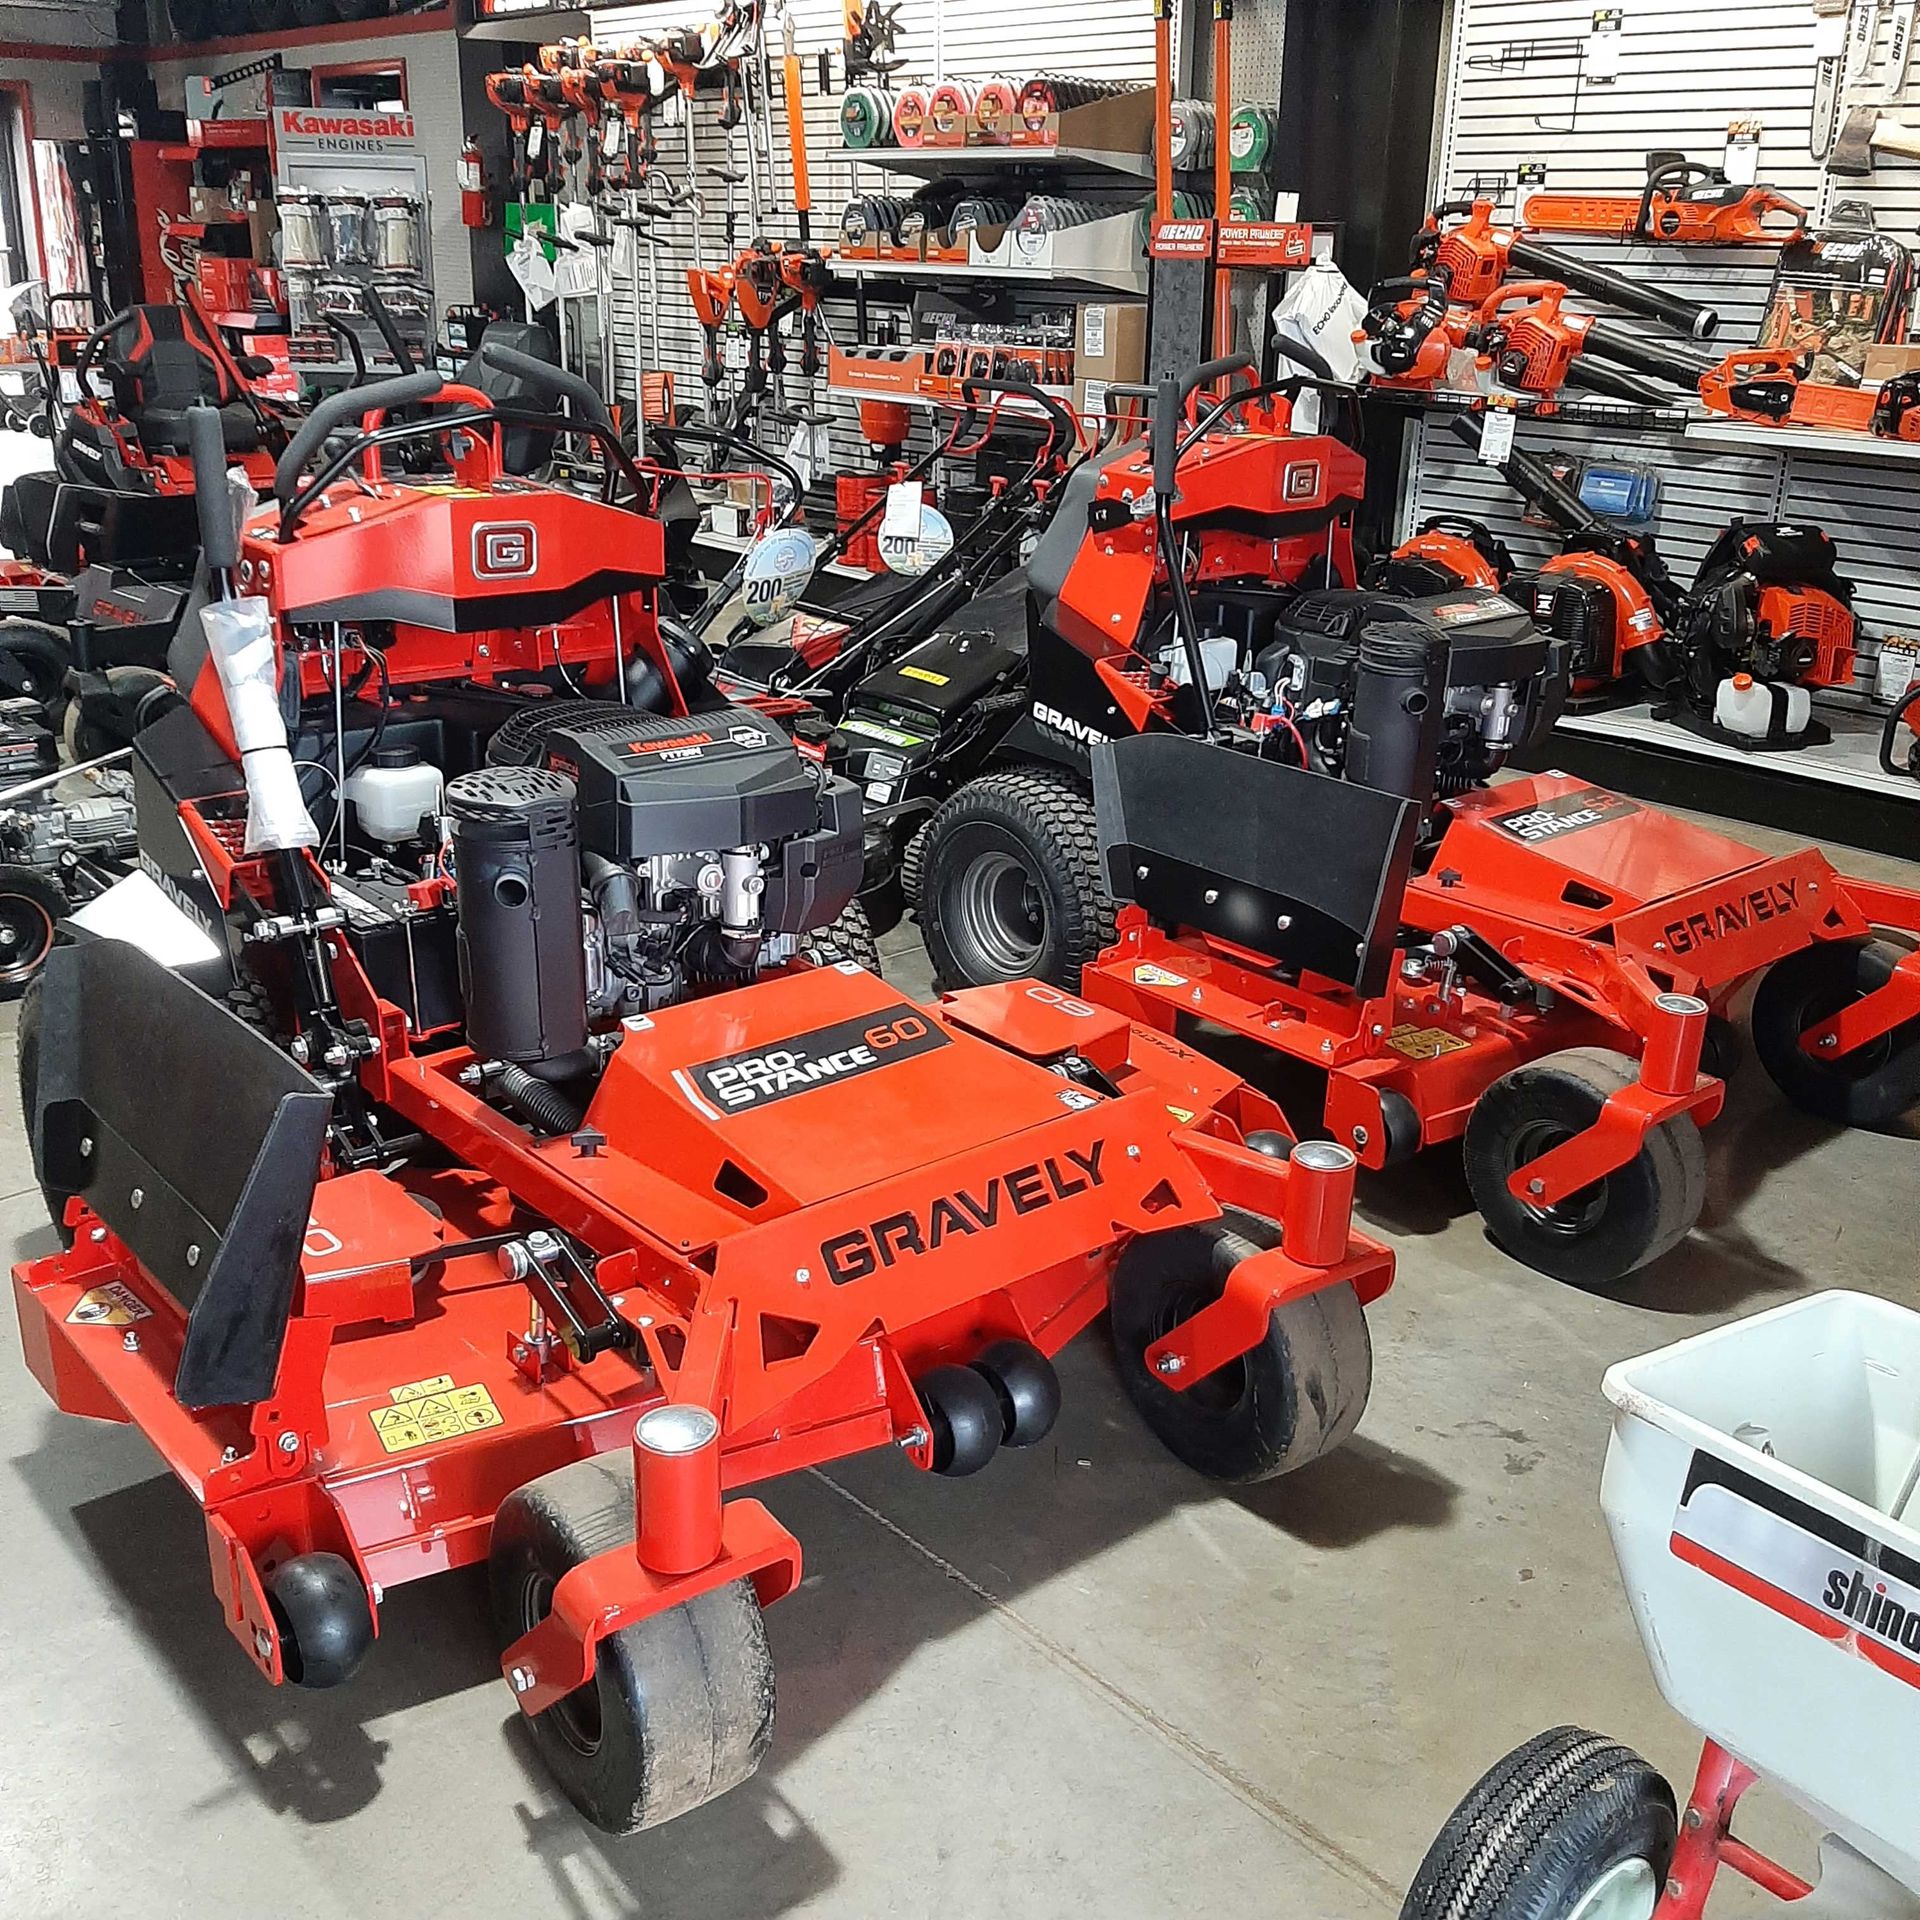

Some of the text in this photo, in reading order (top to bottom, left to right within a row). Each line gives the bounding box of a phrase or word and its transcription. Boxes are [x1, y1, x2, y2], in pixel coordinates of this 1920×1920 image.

[1892, 23, 1905, 61] ECHO
[282, 111, 415, 137] Kawasaki
[318, 138, 383, 150] ENGINES
[1158, 224, 1205, 240] ECHO
[1219, 227, 1249, 239] POWER
[1312, 311, 1331, 335] ECHO
[746, 578, 782, 604] 200
[628, 732, 713, 753] Kawasaki
[1503, 811, 1556, 831] PRO-
[1518, 809, 1602, 840] STANCE
[1664, 877, 1800, 955] GRAVELY
[706, 1050, 807, 1090] PRO-
[718, 1016, 928, 1107] STANCE 60
[820, 1139, 1105, 1286] GRAVELY
